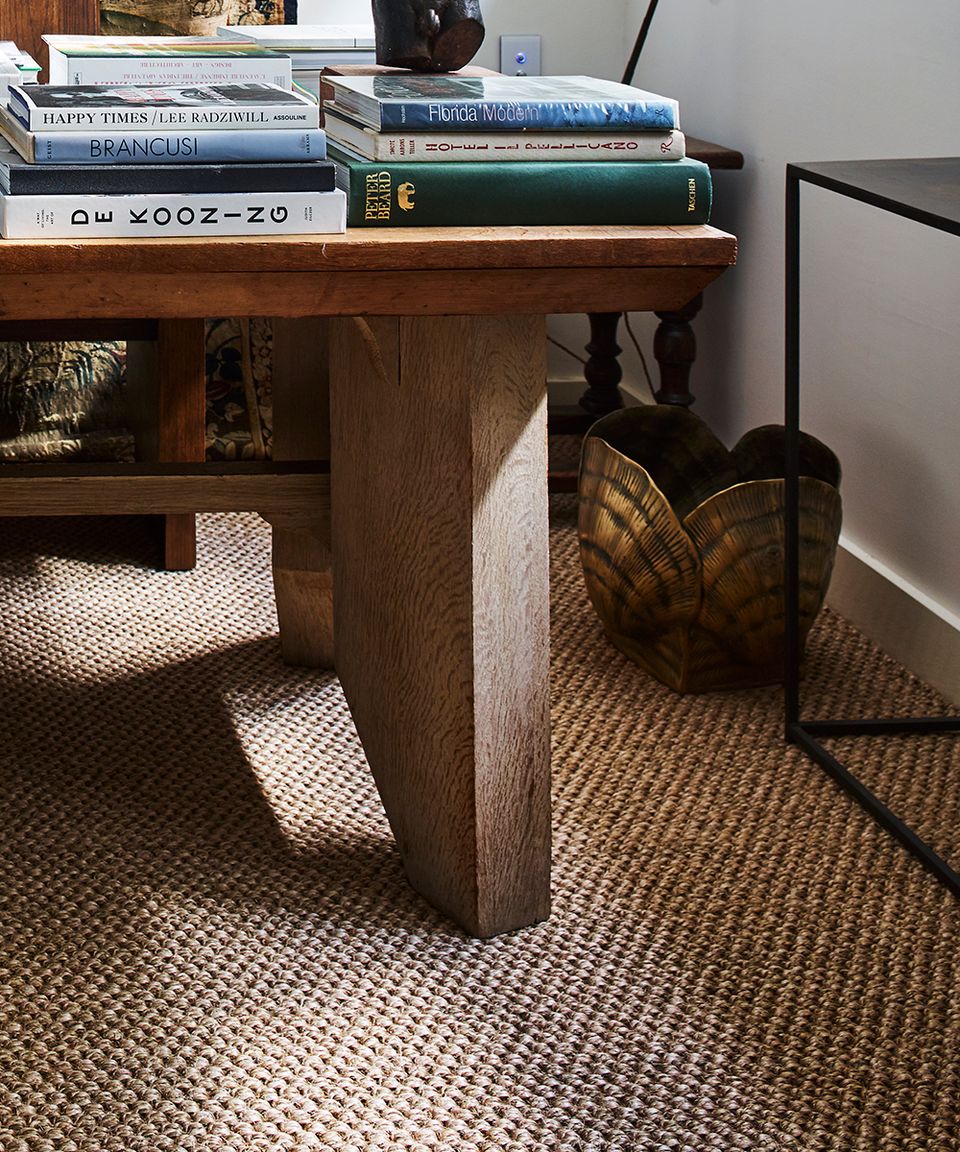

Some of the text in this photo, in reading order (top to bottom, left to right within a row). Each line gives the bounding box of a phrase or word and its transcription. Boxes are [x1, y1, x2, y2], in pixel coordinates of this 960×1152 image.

[43, 112, 97, 126] HAPPY
[100, 112, 148, 125] TIMES
[191, 111, 269, 123] RADZIWILL
[429, 103, 539, 122] Florida Modern
[90, 137, 198, 158] BRANCUSI
[426, 143, 488, 151] HOTEL
[525, 141, 638, 151] PELLICANO
[365, 172, 378, 220] PETER
[378, 170, 391, 220] BEARD
[71, 209, 113, 225] DE
[130, 206, 288, 224] KOONING
